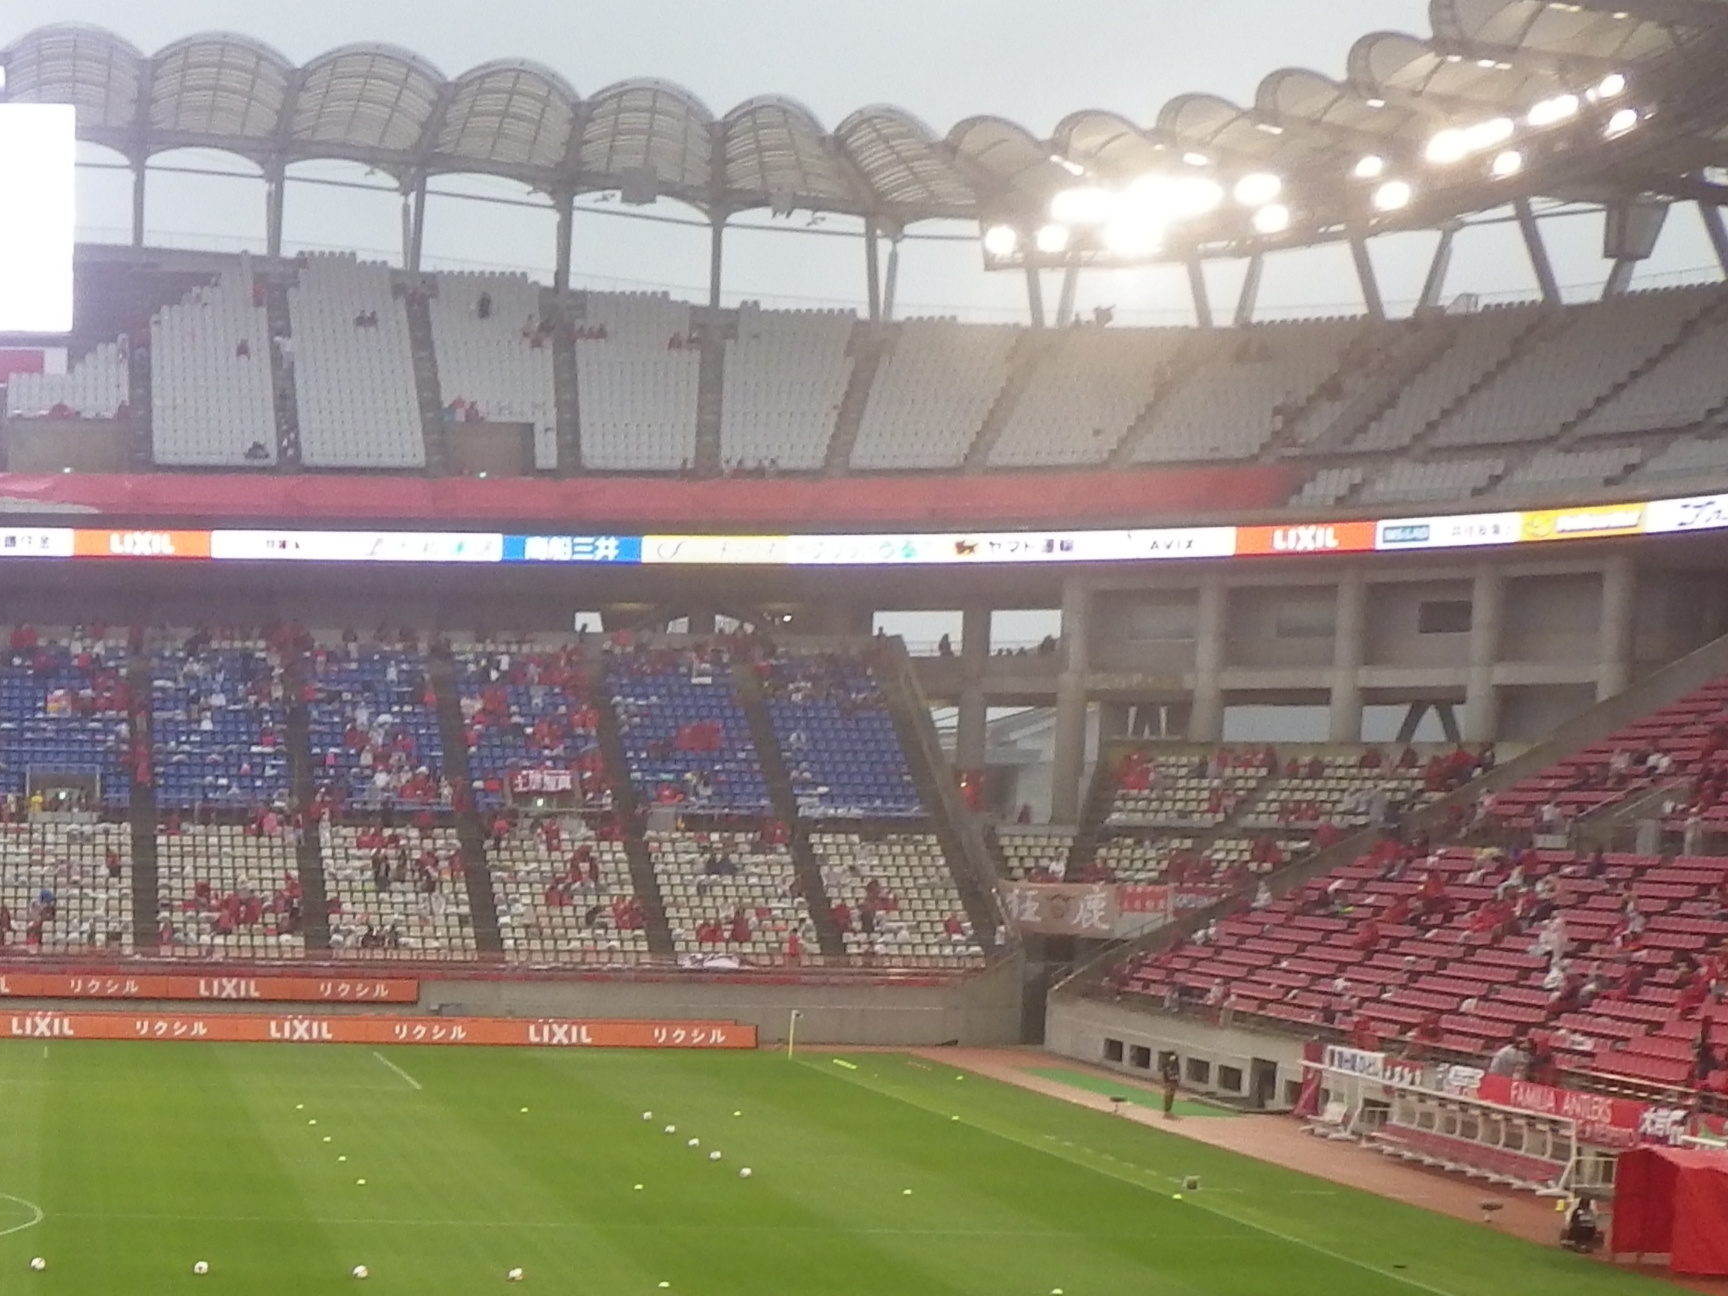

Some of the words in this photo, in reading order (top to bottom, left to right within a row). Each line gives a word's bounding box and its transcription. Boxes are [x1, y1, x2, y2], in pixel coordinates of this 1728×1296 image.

[109, 531, 176, 556] LIXIL
[1272, 525, 1340, 551] LIXIL
[69, 978, 139, 995] リクシル
[198, 977, 261, 997] LIXIL
[319, 980, 389, 998] リクシル
[11, 1016, 75, 1036] LIXIL
[135, 1019, 208, 1037] リクシル
[269, 1020, 334, 1040] LIXIL
[393, 1023, 467, 1041] リクシル
[528, 1023, 593, 1044] LIXIL
[653, 1027, 727, 1045] リクシル
